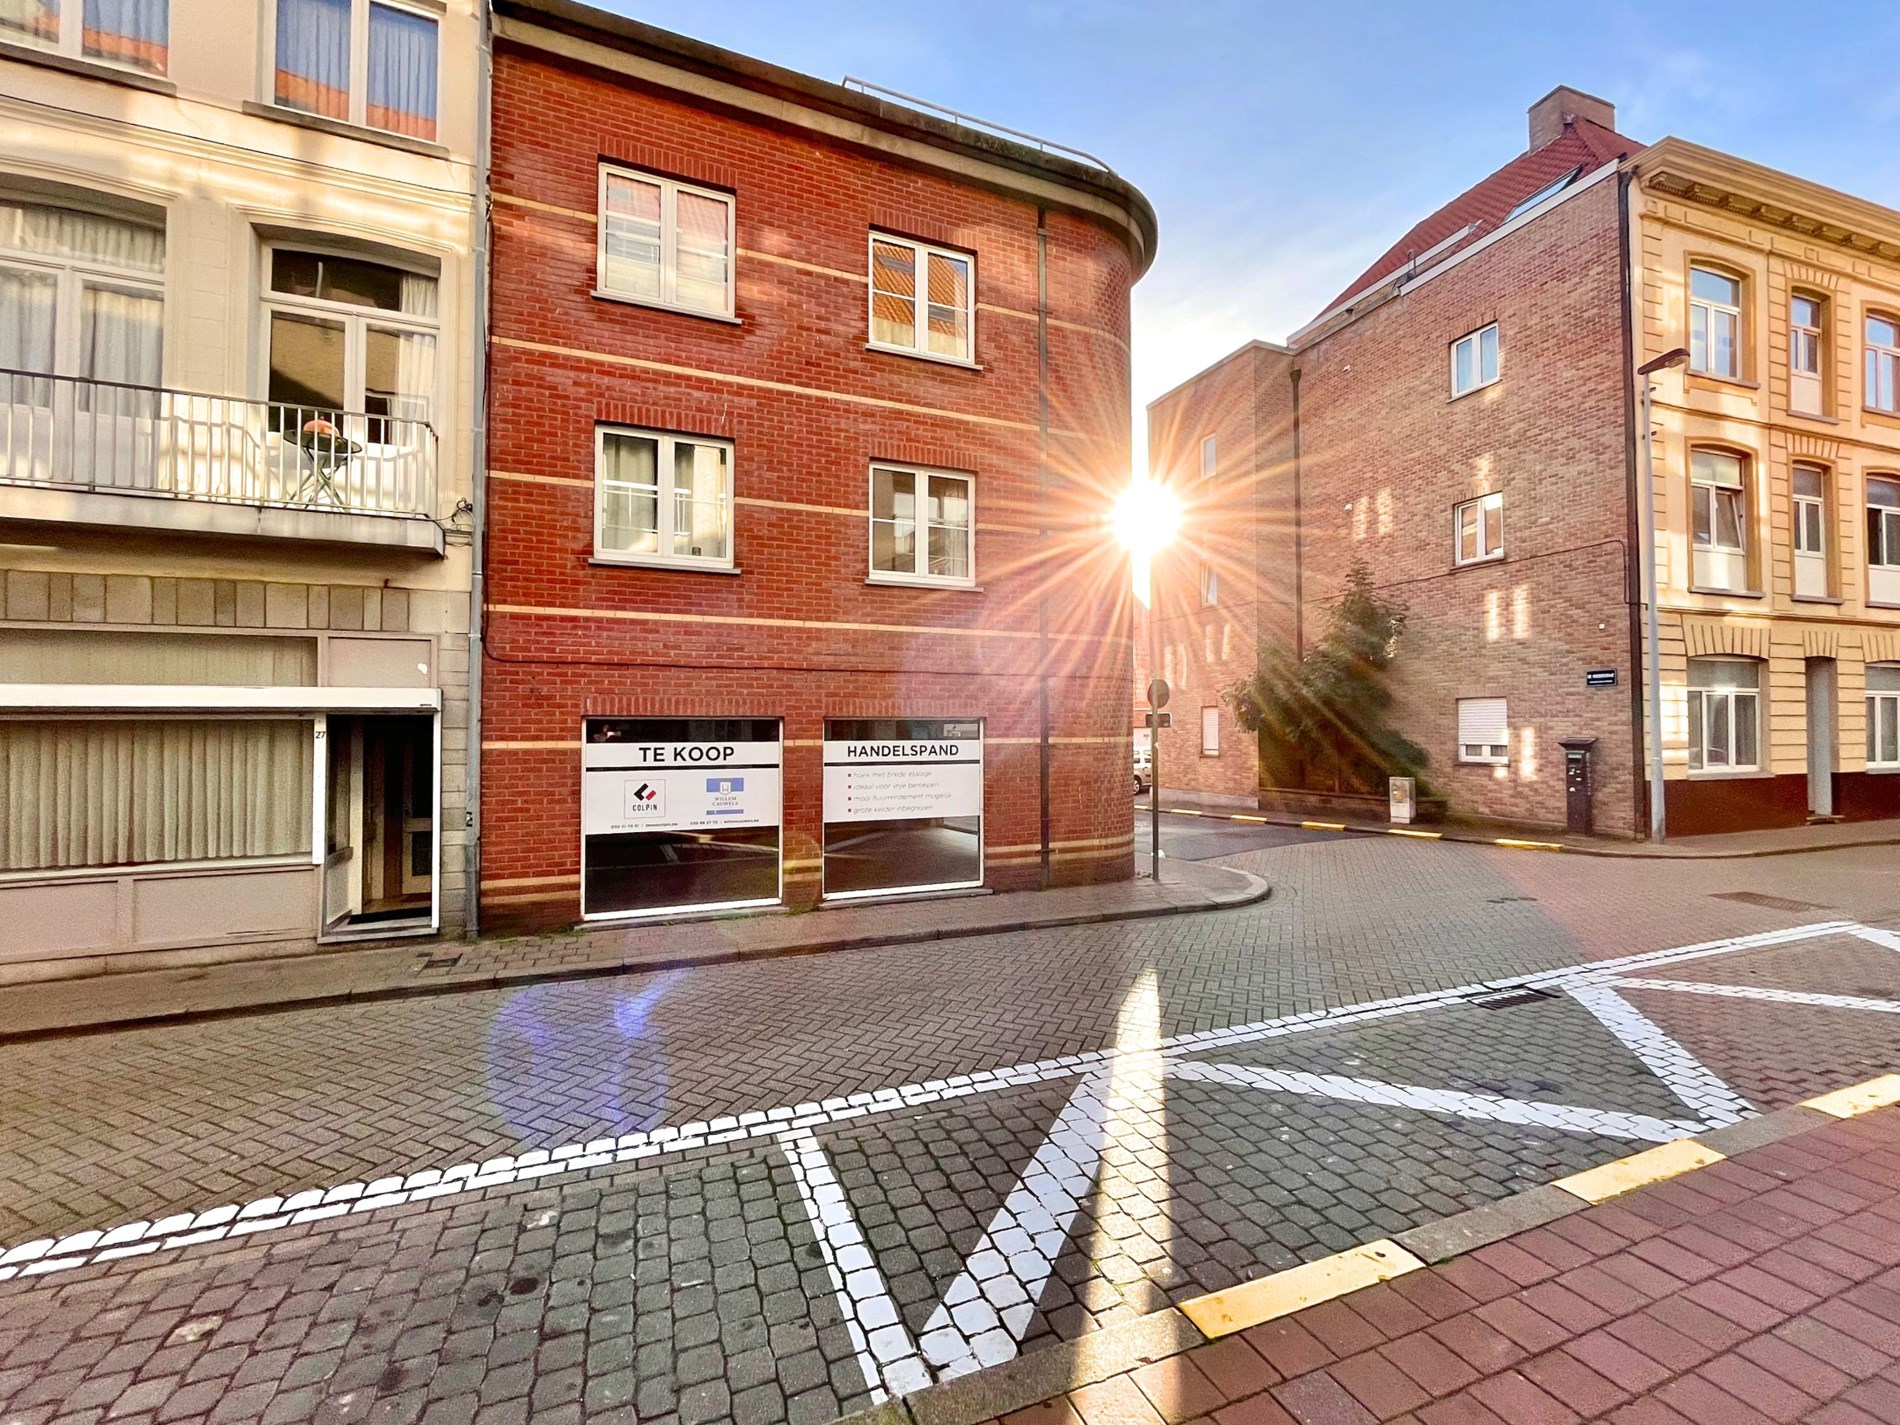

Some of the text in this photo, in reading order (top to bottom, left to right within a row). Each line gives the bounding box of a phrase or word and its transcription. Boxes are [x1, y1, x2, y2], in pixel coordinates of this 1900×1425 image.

[315, 731, 326, 739] 27
[638, 745, 735, 763] TE KOOP
[847, 744, 959, 757] HANDELSPAND
[632, 803, 658, 812] COLPIN
